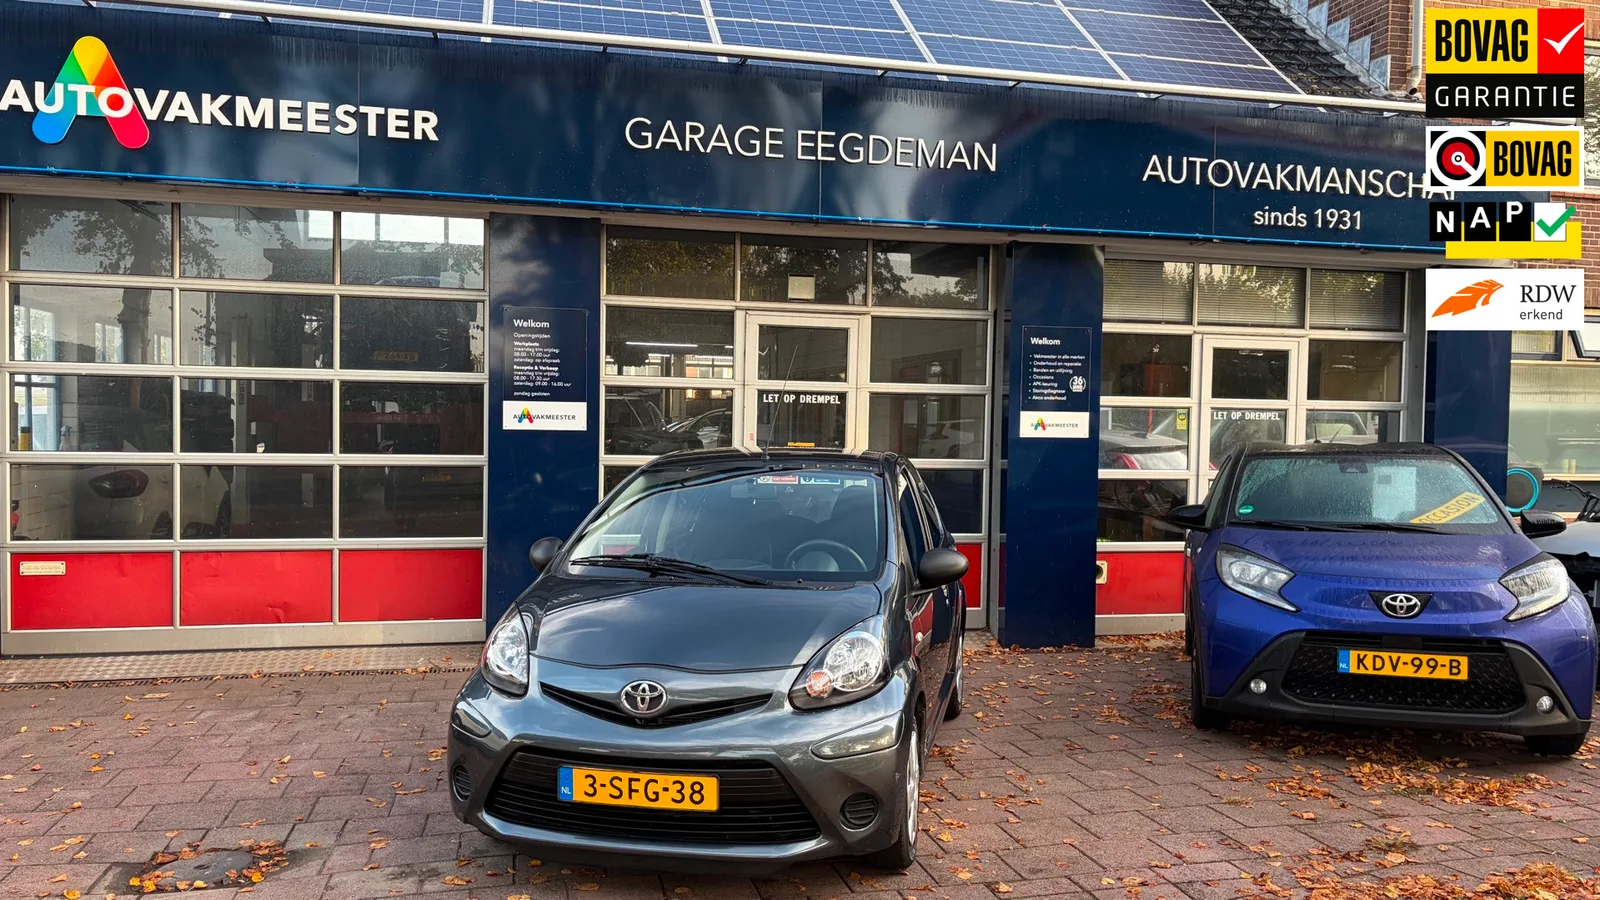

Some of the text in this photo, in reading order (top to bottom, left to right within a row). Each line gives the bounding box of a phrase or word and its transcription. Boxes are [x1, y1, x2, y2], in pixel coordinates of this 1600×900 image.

[0, 79, 439, 142] AUTOVAKMEESTER
[625, 117, 997, 171] GARAGE EEGDEMAN
[1142, 154, 1455, 200] AUTOVAKMANSCH
[1253, 206, 1361, 230] sinds 1931
[513, 319, 550, 328] Welkom
[1030, 337, 1061, 345] Welkom
[1072, 376, 1083, 385] 36
[762, 394, 840, 404] LET OP DREMPEL
[1213, 412, 1280, 420] LET OP DREMPEL
[1356, 653, 1462, 676] KDV-99-B
[560, 774, 705, 805] NL 3-SFG-38
